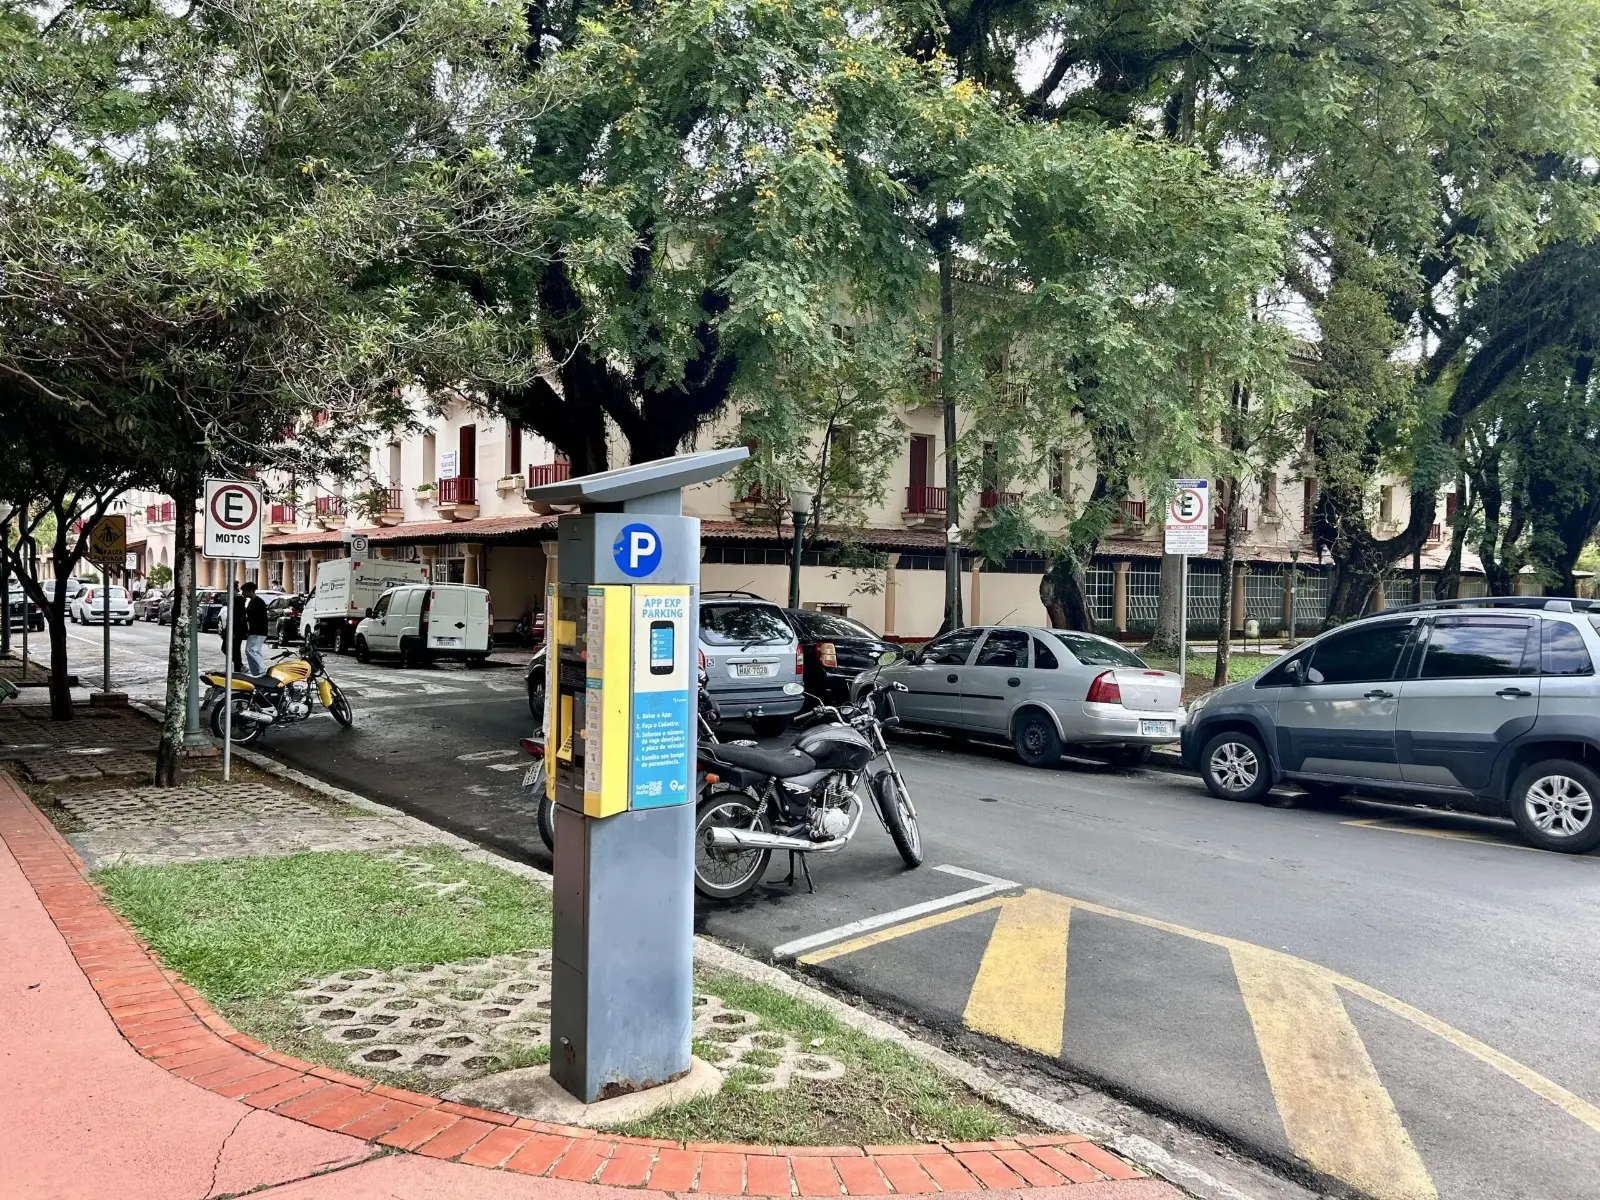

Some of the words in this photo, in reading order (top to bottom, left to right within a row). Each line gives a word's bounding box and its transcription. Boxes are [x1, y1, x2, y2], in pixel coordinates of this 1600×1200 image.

[225, 492, 243, 523] E
[1181, 496, 1192, 516] E
[216, 533, 250, 544] MOTOS
[630, 531, 656, 568] P
[644, 598, 663, 607] APP
[665, 598, 681, 607] EXP
[642, 609, 683, 618] PARKING
